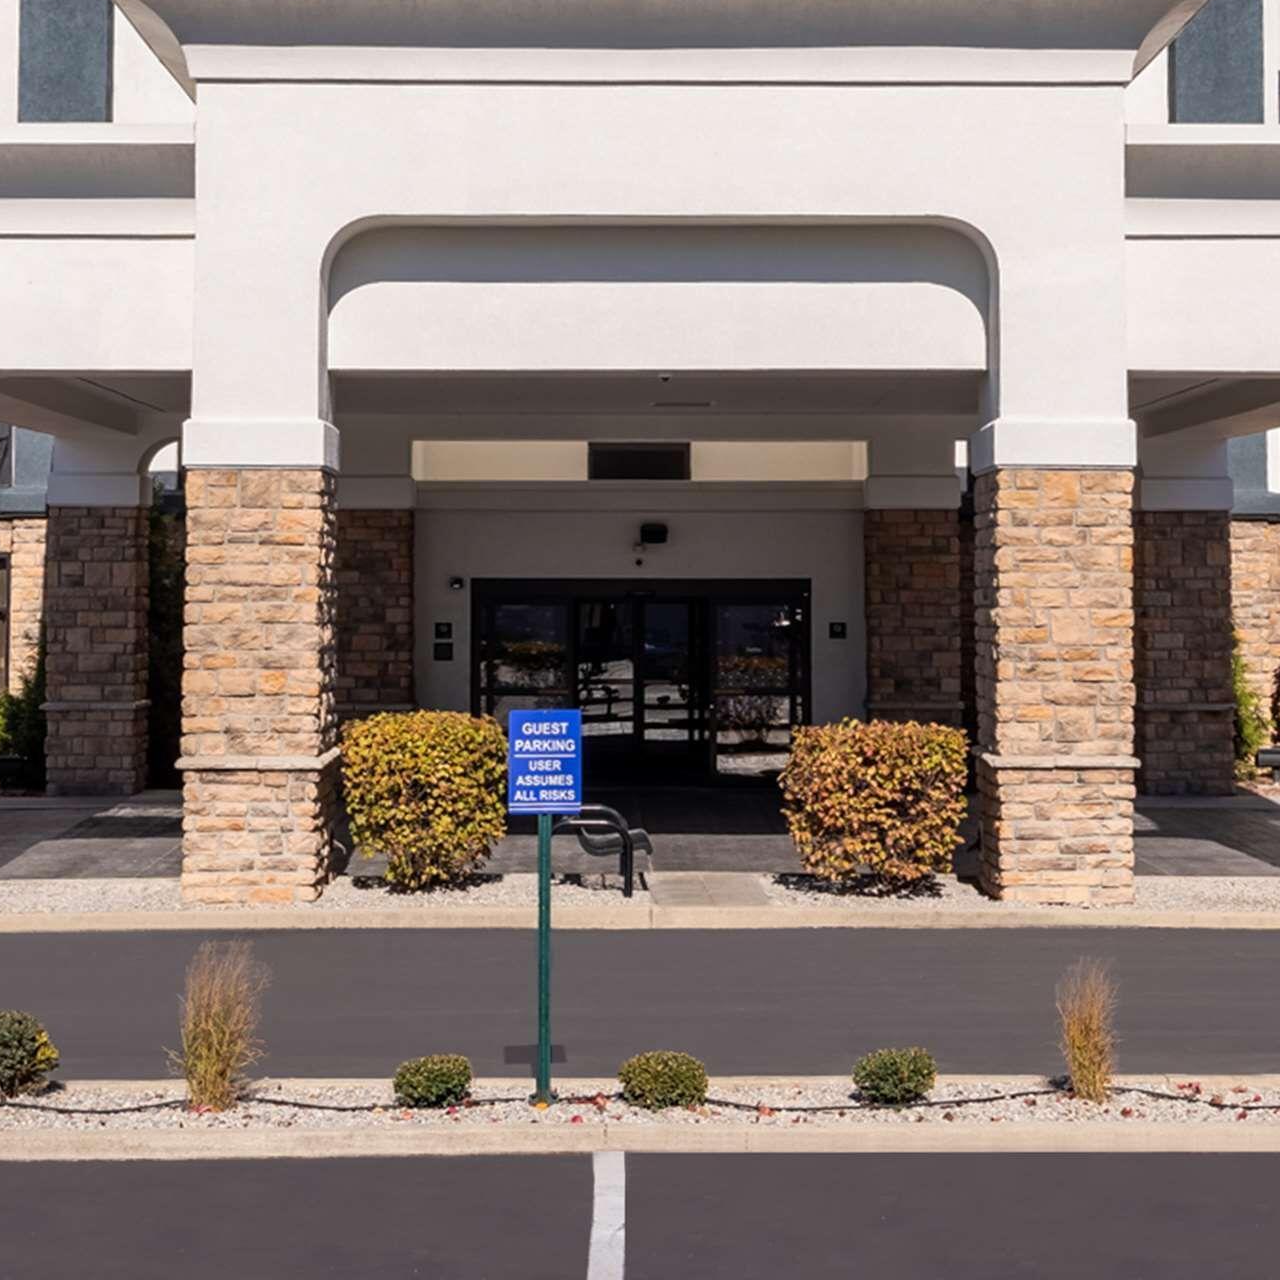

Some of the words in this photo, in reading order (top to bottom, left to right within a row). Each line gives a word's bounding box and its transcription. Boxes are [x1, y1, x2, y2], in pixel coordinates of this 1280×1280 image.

[522, 722, 569, 735] GUEST
[514, 739, 576, 752] PARKING
[528, 760, 562, 771] USER
[516, 774, 574, 786] ASSUMES
[514, 790, 537, 801] ALL
[539, 789, 575, 801] RISKS
